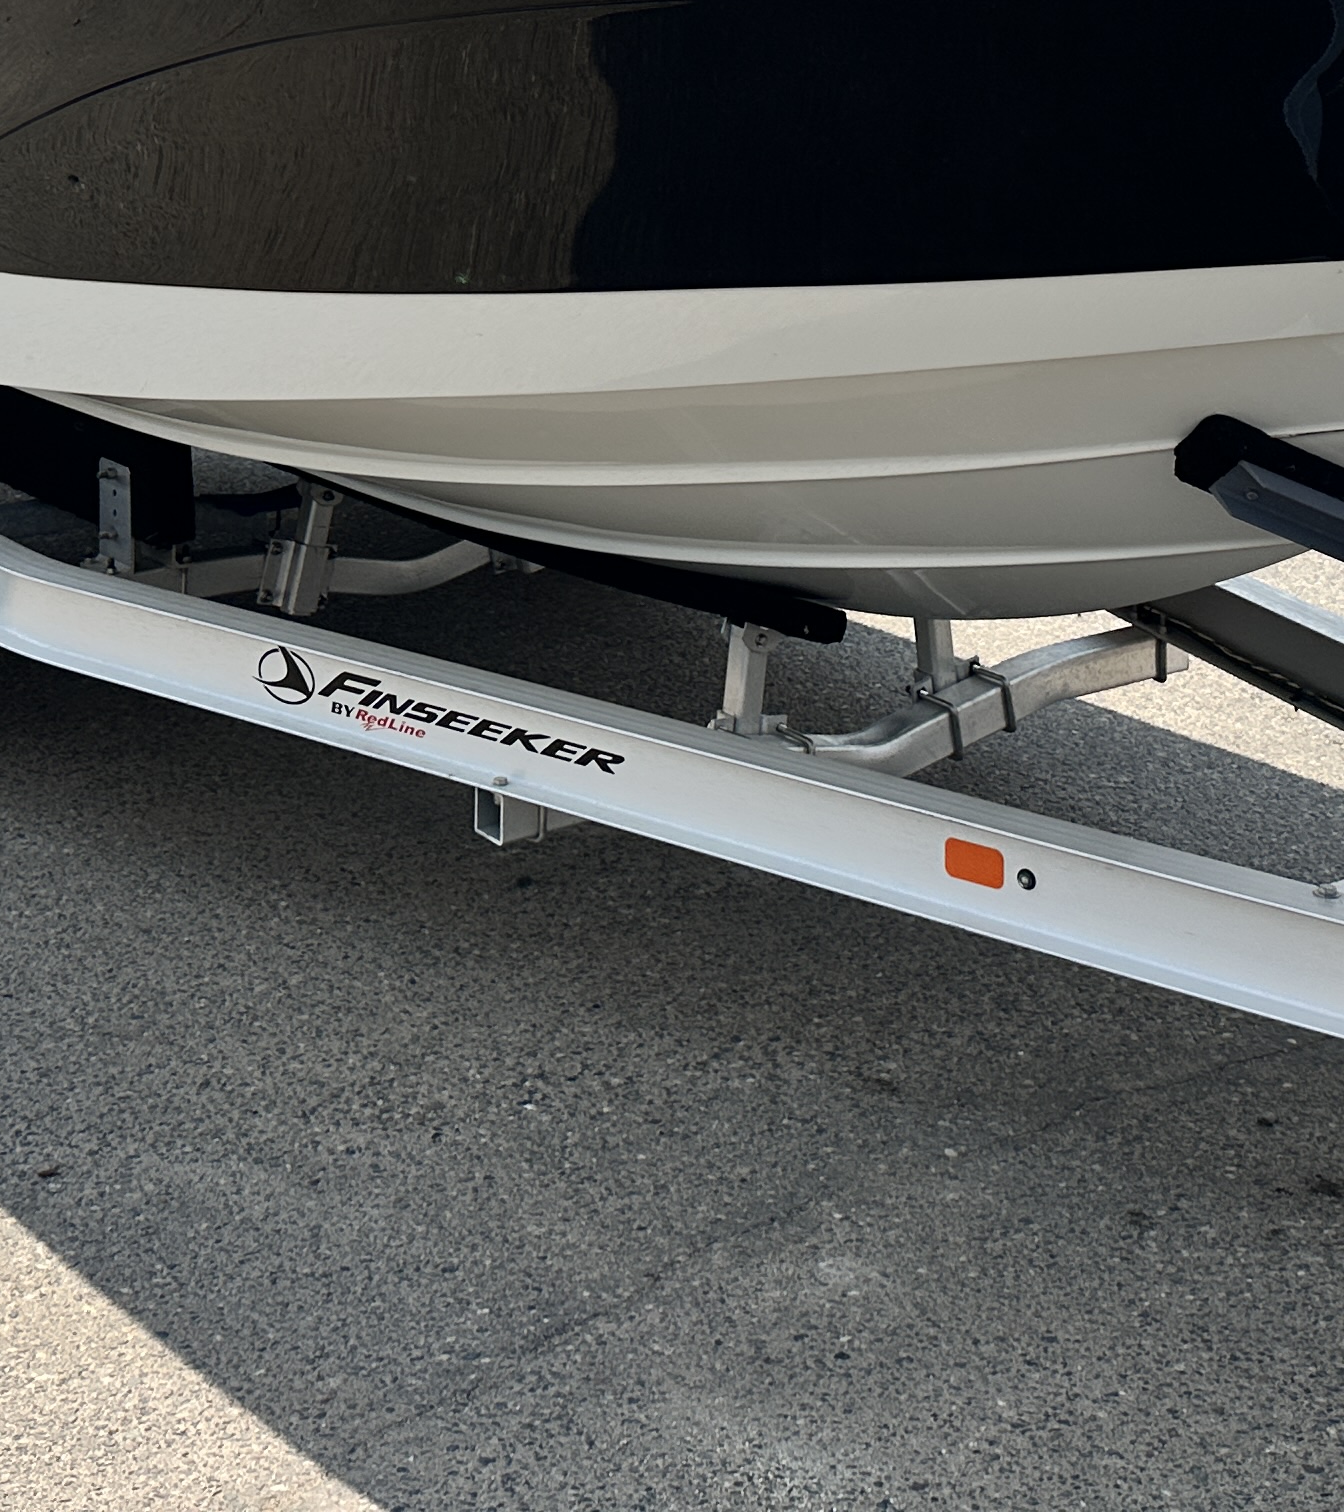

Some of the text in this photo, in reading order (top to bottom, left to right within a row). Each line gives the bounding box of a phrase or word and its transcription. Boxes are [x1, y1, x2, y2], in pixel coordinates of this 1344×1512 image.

[317, 671, 626, 775] FINSEEKER
[331, 701, 426, 739] BY RedLine
